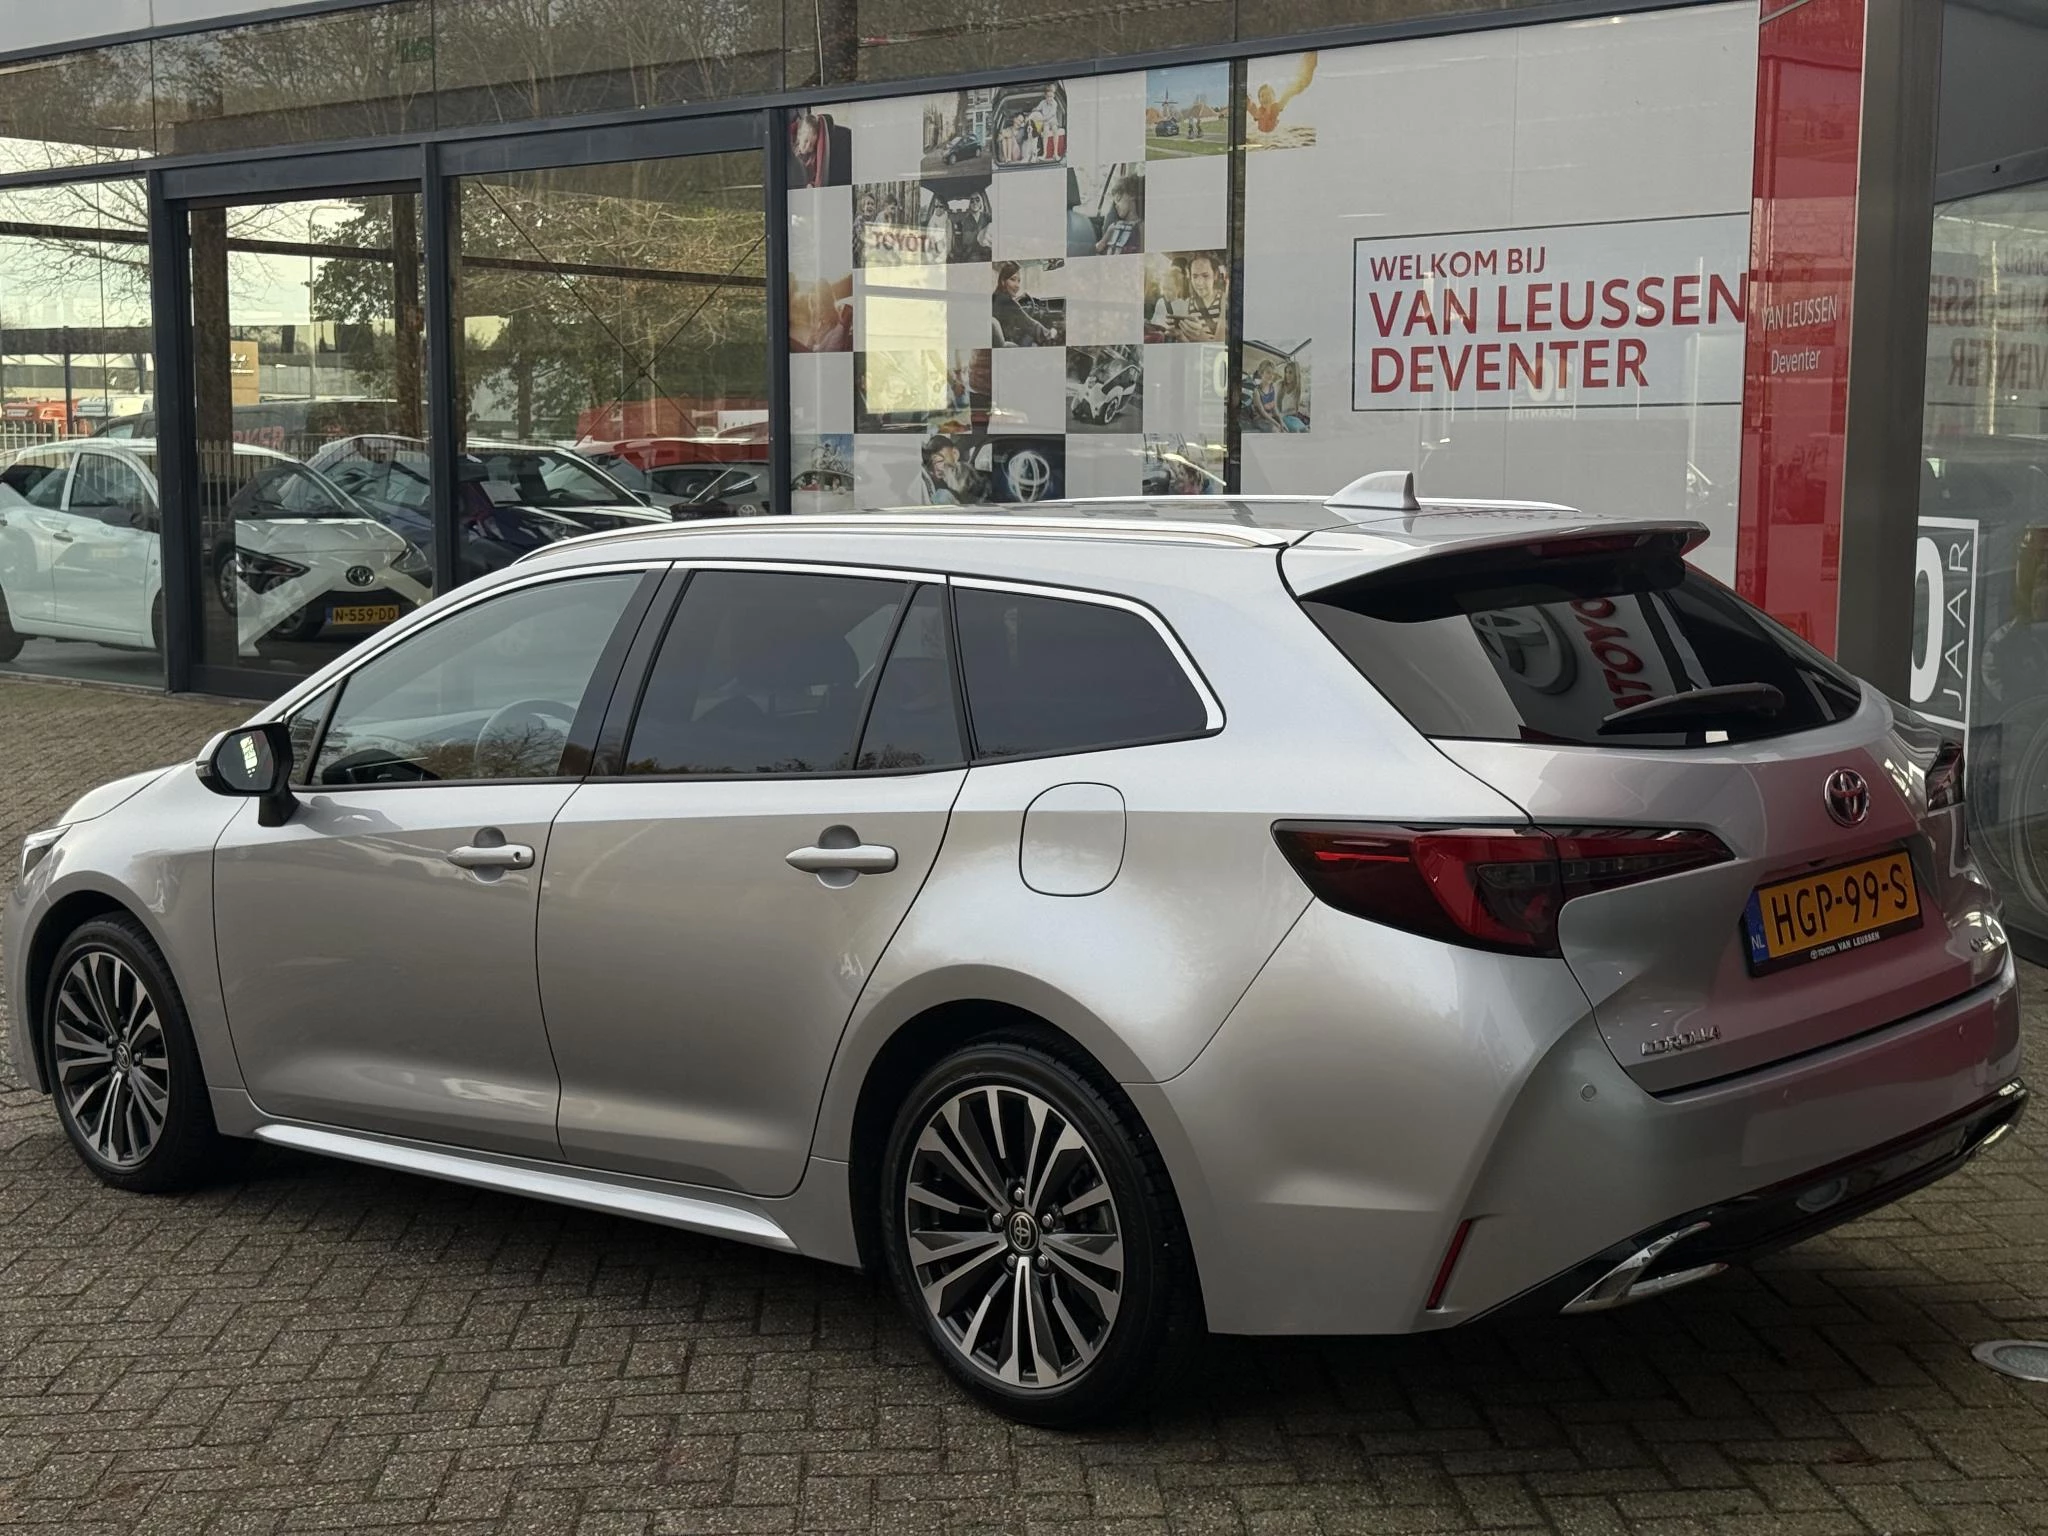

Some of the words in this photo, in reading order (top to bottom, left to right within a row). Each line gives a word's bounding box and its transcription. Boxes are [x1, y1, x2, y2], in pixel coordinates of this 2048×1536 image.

[1369, 249, 1498, 282] WELKOM
[1506, 246, 1546, 275] BIJ
[1368, 287, 1479, 338] VAN
[1497, 272, 1748, 333] LEUSSEN
[1761, 303, 1785, 332] VAN
[1786, 294, 1838, 329] LEUSSEN
[1370, 337, 1650, 393] DEVENTER
[1771, 346, 1821, 375] Deventer
[1943, 540, 1970, 712] JAAR
[1770, 863, 1908, 946] HGP-99-S
[1751, 934, 1766, 951] NL
[1838, 940, 1852, 952] VAN
[1852, 931, 1881, 946] LEUSSEN
[1640, 1025, 1721, 1056] COROLLA
